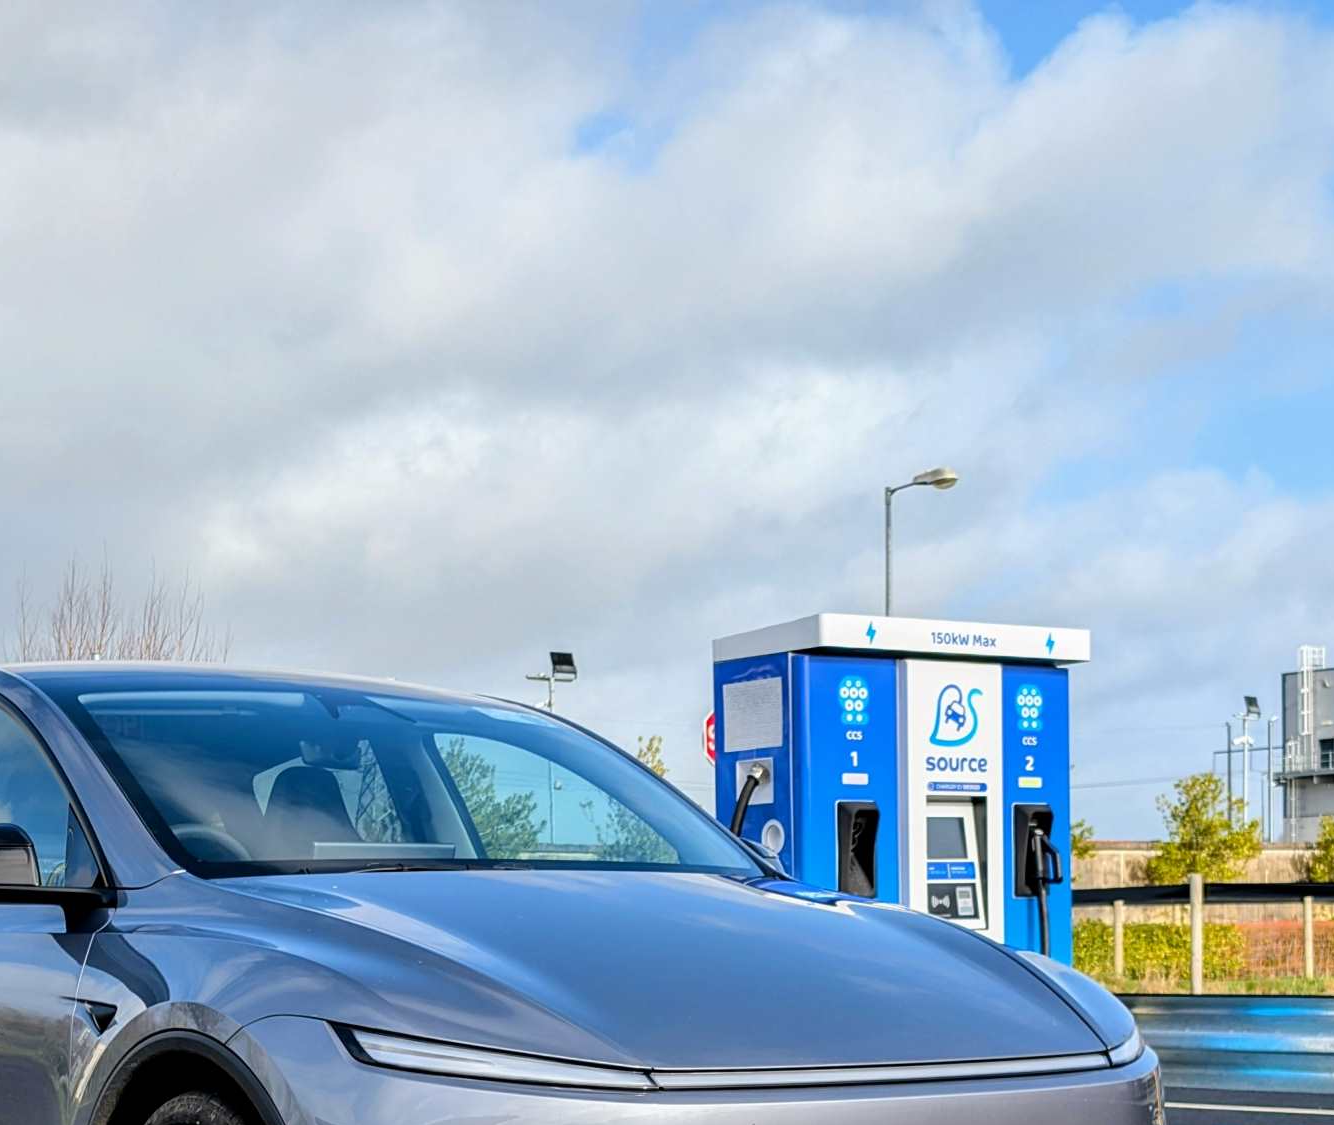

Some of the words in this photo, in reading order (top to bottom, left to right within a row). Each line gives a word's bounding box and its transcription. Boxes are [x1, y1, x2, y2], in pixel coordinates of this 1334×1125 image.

[931, 632, 969, 646] 150kW
[972, 634, 997, 647] Max
[846, 731, 862, 740] CCS
[1022, 736, 1037, 746] CCS
[850, 751, 858, 767] 1
[925, 756, 988, 772] source
[1025, 756, 1034, 771] 2
